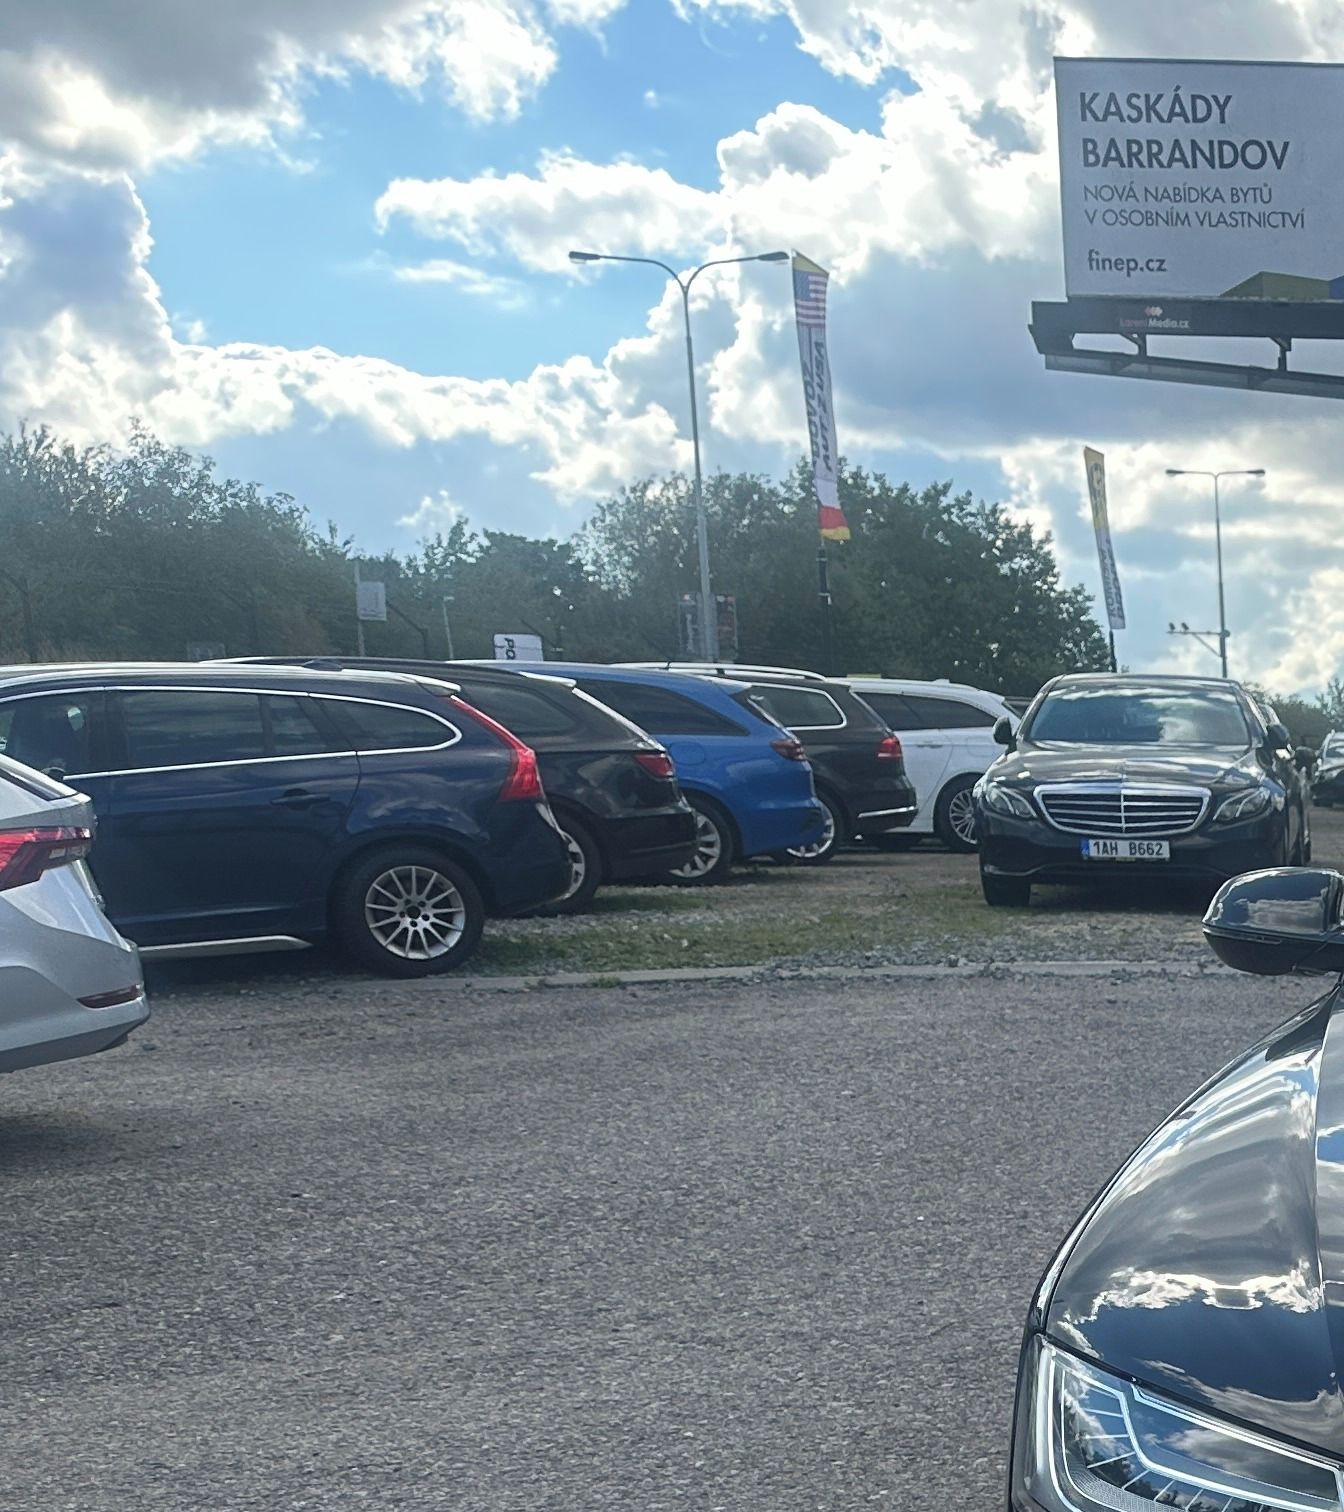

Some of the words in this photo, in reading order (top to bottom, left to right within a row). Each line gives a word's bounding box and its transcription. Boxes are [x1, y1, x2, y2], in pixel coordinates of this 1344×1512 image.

[1079, 84, 1233, 125] KASKÁDY
[1081, 137, 1290, 170] BARRANDOV
[1083, 181, 1140, 204] NOVÁ
[1144, 182, 1226, 205] NABÍDKA
[1230, 182, 1273, 205] BYTŮ
[1084, 209, 1098, 225] V
[1102, 206, 1192, 228] OSOBNÍM
[1195, 208, 1306, 229] VLASTNICTVÍ
[1087, 249, 1168, 278] finep.cz
[1092, 841, 1118, 856] 1AH
[1128, 841, 1164, 856] B662
